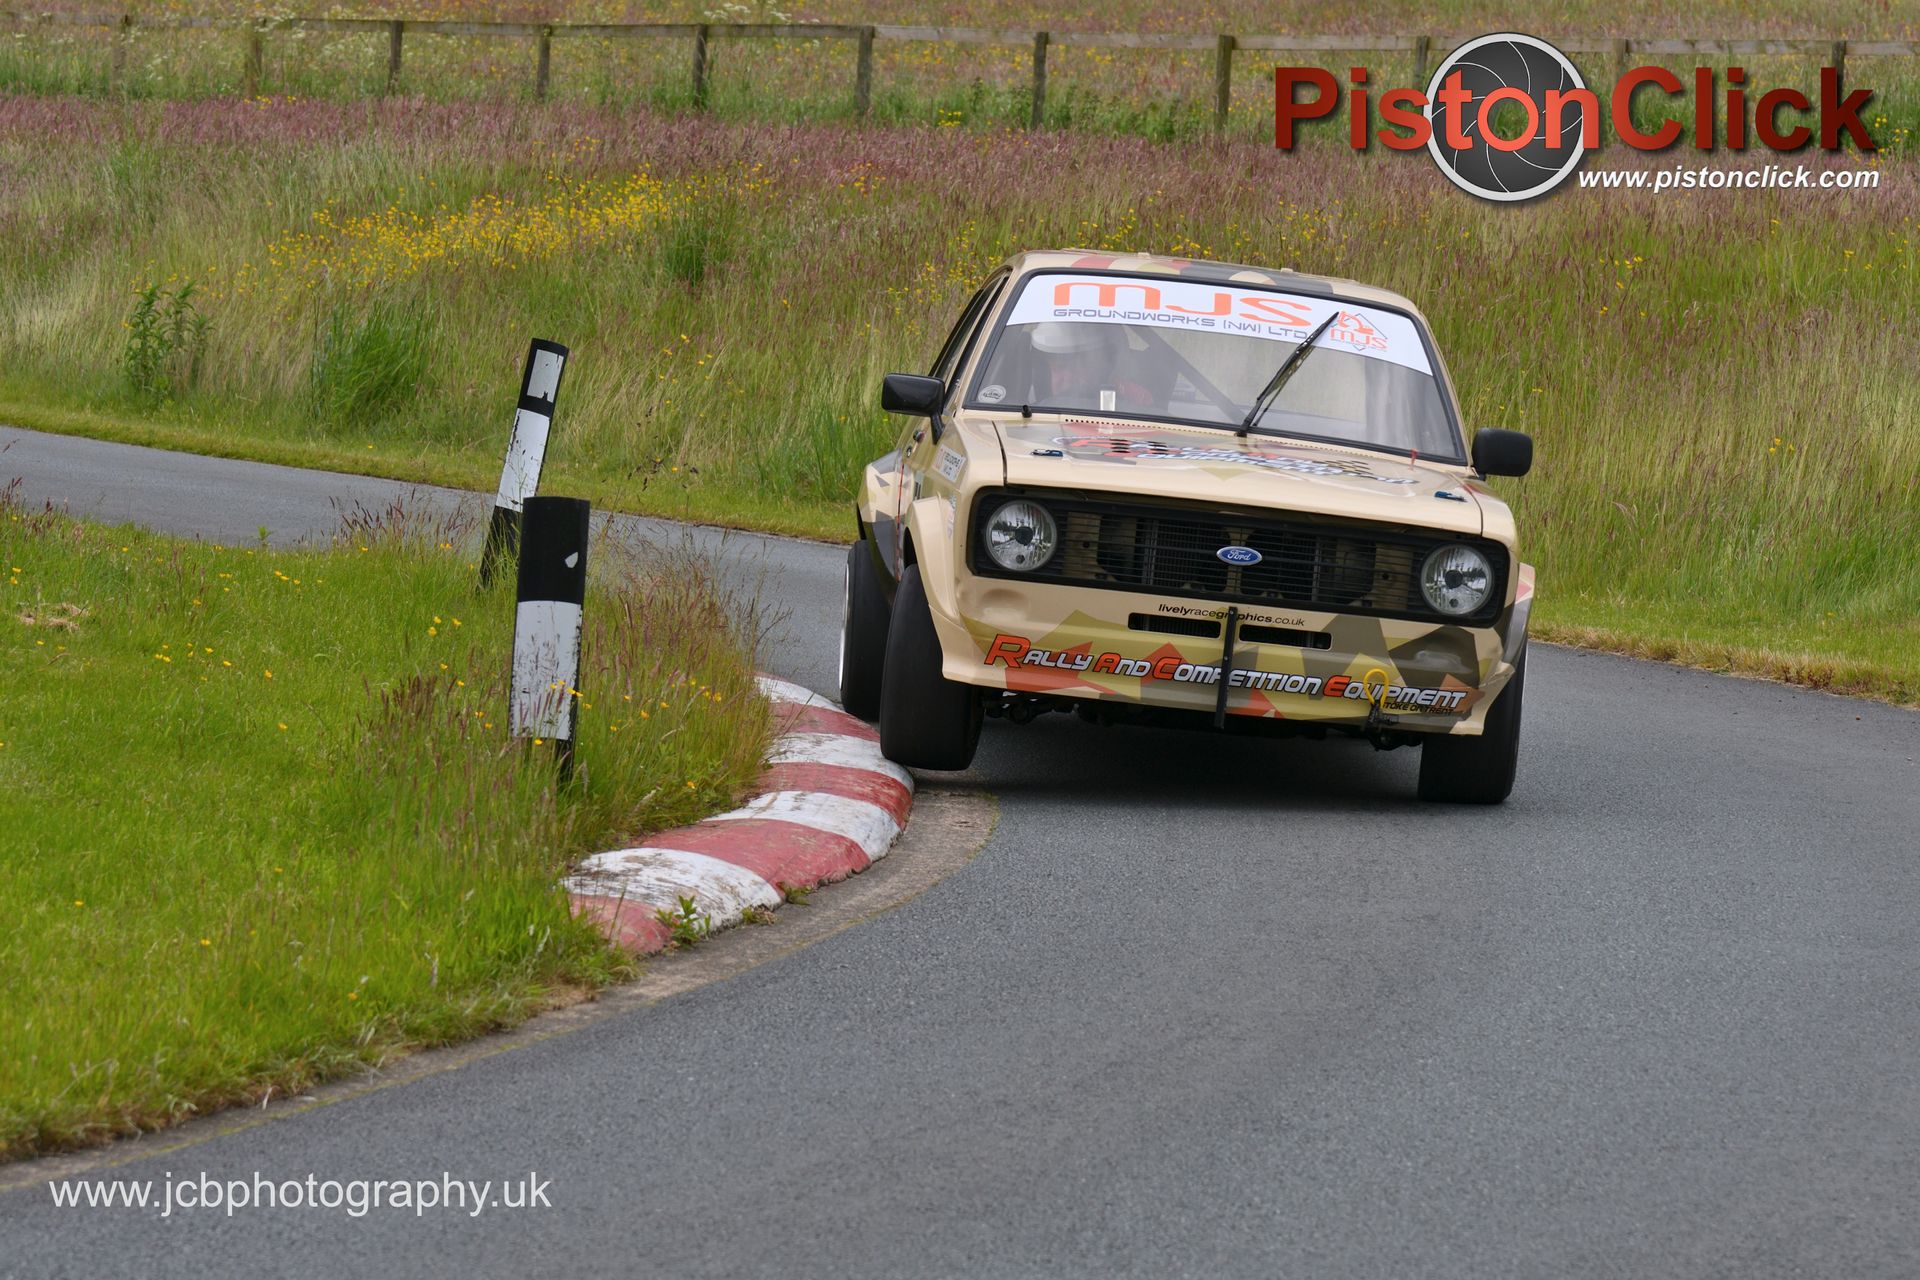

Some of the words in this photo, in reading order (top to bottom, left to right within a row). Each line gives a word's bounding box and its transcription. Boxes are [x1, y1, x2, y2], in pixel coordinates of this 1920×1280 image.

[1053, 282, 1313, 328] MJS
[1053, 308, 1216, 328] GROUNDWORKS
[1267, 326, 1309, 340] LTD
[1330, 328, 1388, 350] MJS
[1227, 549, 1252, 561] Ford
[1158, 603, 1305, 627] livelyracegrphics.co.uk
[1383, 702, 1409, 710] TOKE
